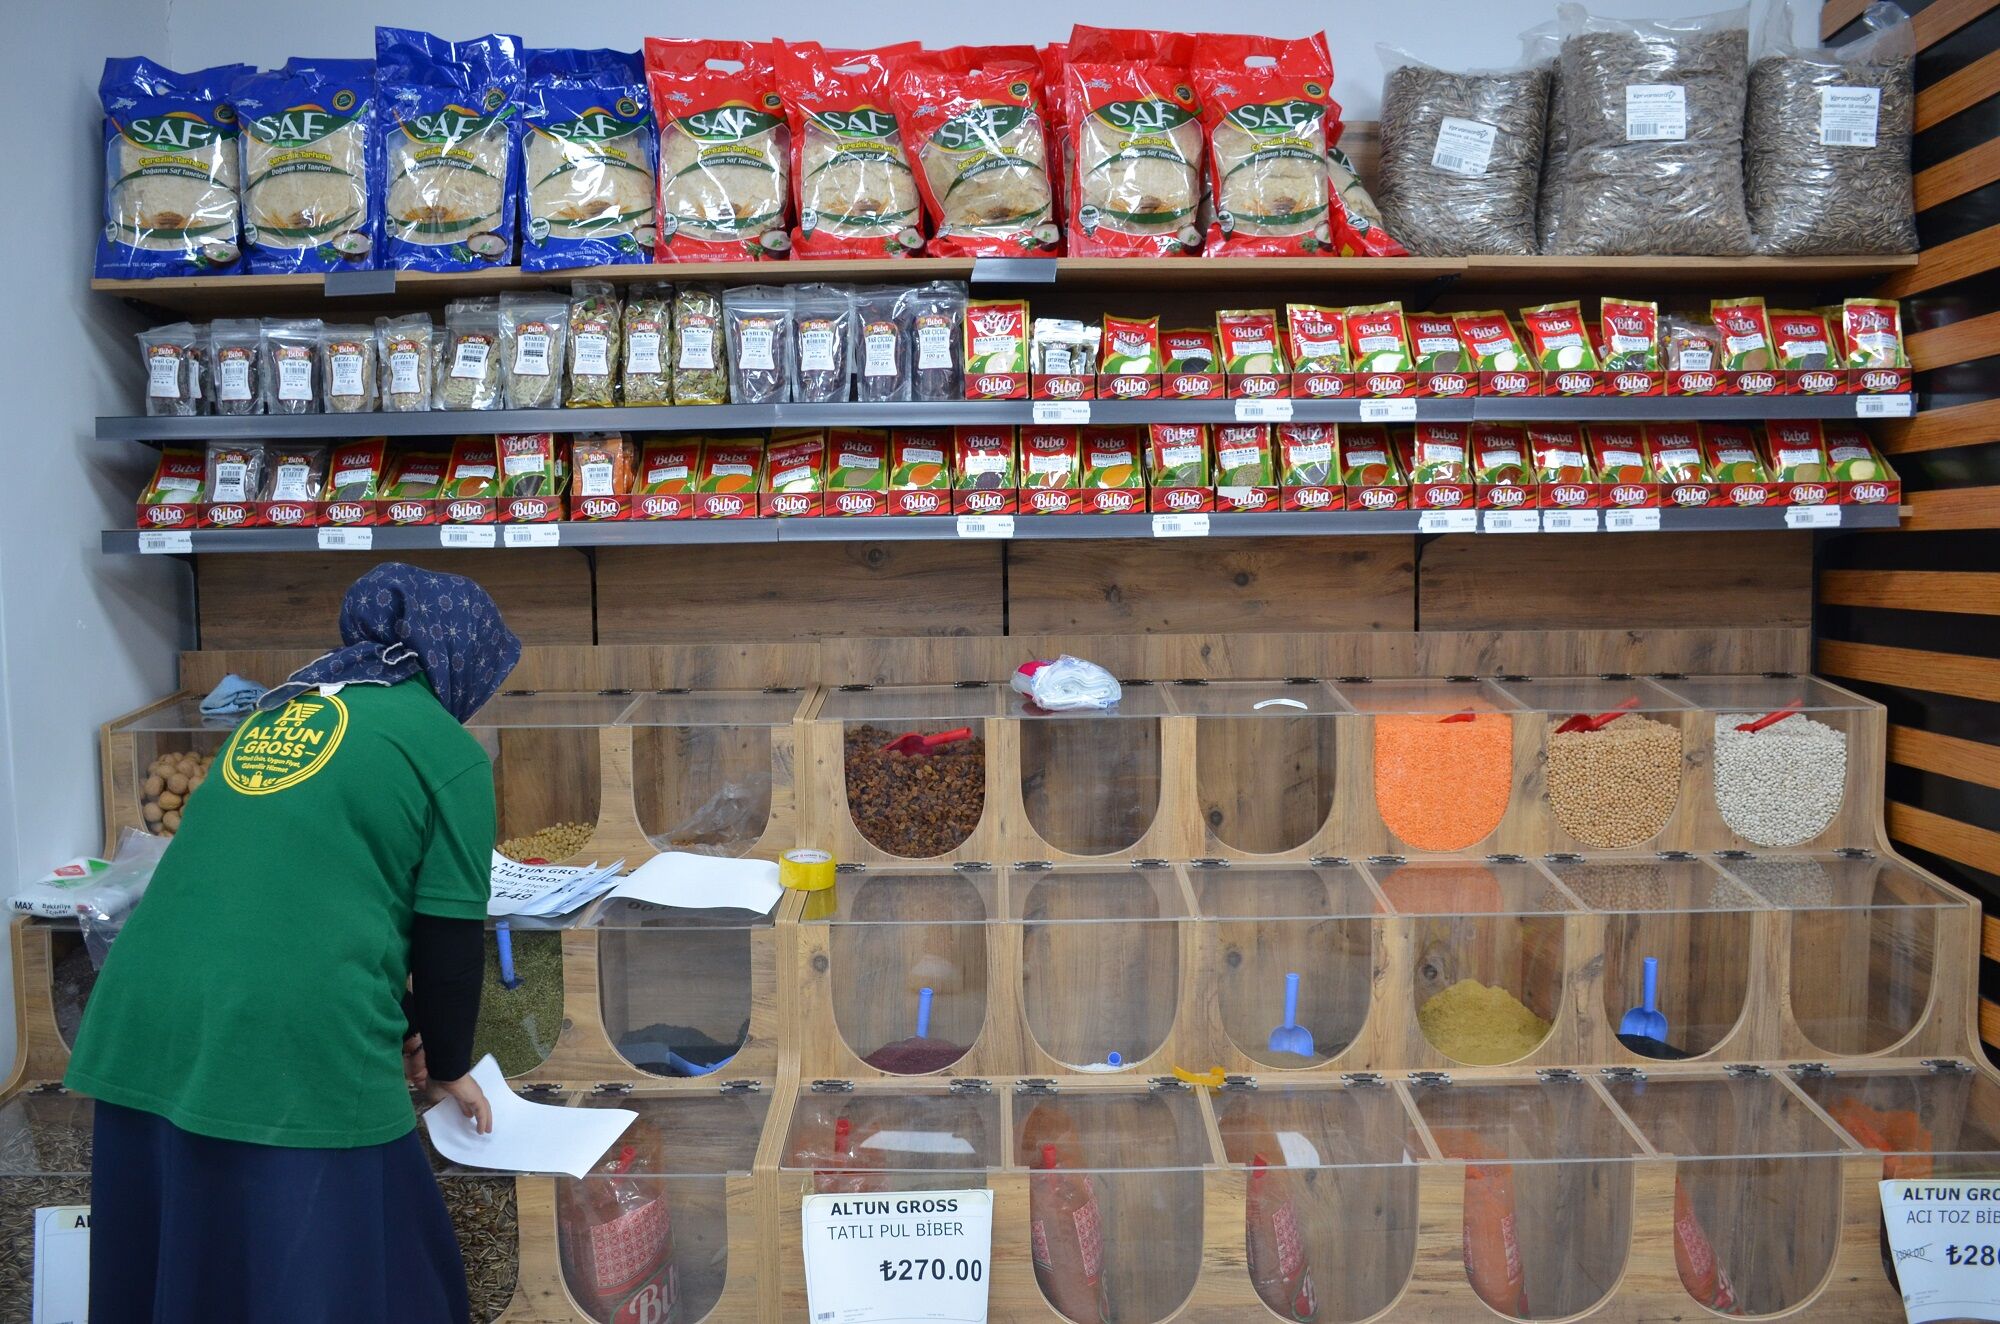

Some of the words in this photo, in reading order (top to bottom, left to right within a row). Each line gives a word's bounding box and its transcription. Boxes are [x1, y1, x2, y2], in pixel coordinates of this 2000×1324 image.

[824, 110, 892, 133] SAF
[1108, 101, 1176, 127] SAF
[1238, 102, 1306, 131] SAF
[257, 112, 329, 141] SAF
[415, 113, 480, 141] SAF
[550, 114, 621, 138] SAF
[689, 109, 759, 137] SAF
[131, 118, 211, 147] SAF
[730, 147, 763, 157] Tarhana
[139, 156, 175, 165] Çerezlik
[170, 167, 182, 175] Saf
[1302, 322, 1333, 335] Biba
[1360, 323, 1391, 334] Biba
[1421, 322, 1452, 334] Biba
[1540, 320, 1571, 332] Biba
[1614, 317, 1643, 331] Biba
[1727, 318, 1755, 331] Biba
[1784, 324, 1815, 335] Biba
[1117, 331, 1145, 344] Biba
[1233, 327, 1264, 339] Biba
[1471, 326, 1502, 339] Biba
[979, 375, 1012, 394] Biba
[1048, 377, 1081, 396] Biba
[1114, 376, 1147, 395] Biba
[1177, 376, 1209, 394] Biba
[1243, 377, 1276, 394] Biba
[1308, 376, 1340, 394] Biba
[1369, 375, 1402, 393] Biba
[1432, 375, 1465, 393] Biba
[1494, 375, 1526, 391] Biba
[1559, 375, 1591, 391] Biba
[1617, 375, 1649, 391] Biba
[1681, 373, 1714, 390] Biba
[1740, 373, 1773, 390] Biba
[1801, 372, 1834, 389] Biba
[1864, 371, 1897, 388] Biba
[968, 436, 1000, 447] Biba
[1034, 437, 1065, 449] Biba
[1164, 428, 1196, 442] Biba
[507, 437, 538, 451] Biba
[843, 441, 872, 452] Biba
[1097, 493, 1130, 509] Biba
[1167, 492, 1200, 508] Biba
[1297, 490, 1330, 506] Biba
[1362, 491, 1394, 507] Biba
[1428, 488, 1460, 505] Biba
[1491, 488, 1523, 505] Biba
[1554, 488, 1585, 504] Biba
[1612, 487, 1645, 504] Biba
[1675, 488, 1707, 503] Biba
[1732, 487, 1765, 503] Biba
[1792, 485, 1824, 501] Biba
[1853, 485, 1885, 501] Biba
[513, 501, 545, 517] Biba
[584, 499, 617, 516] Biba
[645, 498, 678, 515] Biba
[707, 497, 741, 514] Biba
[774, 497, 807, 514] Biba
[839, 495, 872, 512] Biba
[903, 494, 936, 511] Biba
[968, 493, 1002, 510] Biba
[1034, 493, 1067, 510] Biba
[150, 506, 182, 522] Biba
[211, 506, 243, 522] Biba
[270, 505, 302, 521] Biba
[329, 504, 361, 520] Biba
[391, 503, 423, 519] Biba
[450, 502, 482, 518] Biba
[244, 726, 324, 745] ALTUN
[244, 741, 306, 758] GROSS
[15, 901, 33, 911] MAX
[1903, 1188, 1960, 1201] ALTUN
[830, 1200, 890, 1216] ALTUN
[896, 1199, 958, 1214] GROSS
[1906, 1210, 1932, 1224] ACI
[1938, 1210, 1970, 1224] TOZ
[827, 1225, 874, 1240] TATLI
[880, 1223, 910, 1238] PUL
[916, 1219, 964, 1237] BİBER
[1945, 1244, 2000, 1266] ₺28
[879, 1258, 982, 1282] ₺270.00
